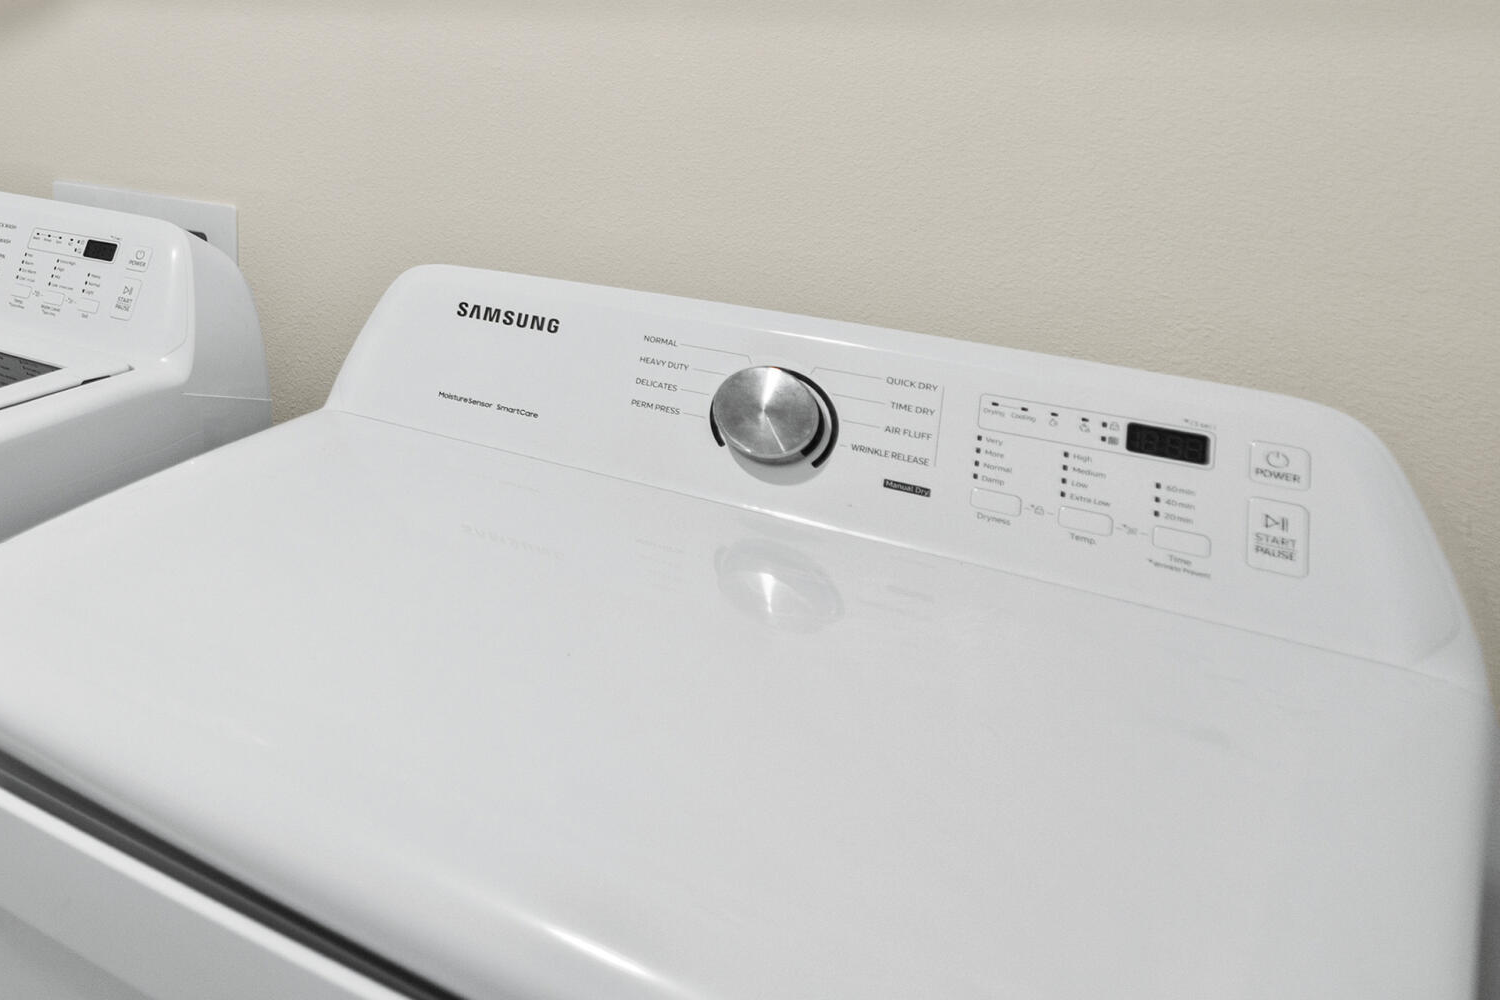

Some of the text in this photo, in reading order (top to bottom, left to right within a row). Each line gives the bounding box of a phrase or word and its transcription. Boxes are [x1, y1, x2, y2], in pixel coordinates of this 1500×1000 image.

[457, 301, 560, 334] SAMSUNG
[644, 334, 678, 347] NORMAL
[640, 356, 690, 371] HEAVY DUTY
[635, 377, 678, 392] DELICATES
[886, 376, 939, 392] QUICK DRY
[438, 391, 539, 419] MoistureSensor SmartCare
[631, 398, 681, 415] PERM PRESS
[891, 401, 936, 416] TIME DRY
[884, 425, 933, 440] AIR FLUFF
[985, 436, 1003, 446] Very
[851, 443, 930, 466] WRINKLE RELEASE
[985, 449, 1004, 458] More
[983, 462, 1012, 473] Normal
[1072, 466, 1107, 479] Medium
[1255, 467, 1301, 483] POWER
[981, 475, 1005, 486] Damp
[1071, 480, 1088, 489] Low
[885, 480, 930, 497] Manual Dry
[1255, 532, 1296, 548] START
[1255, 545, 1296, 561] PAUSE
